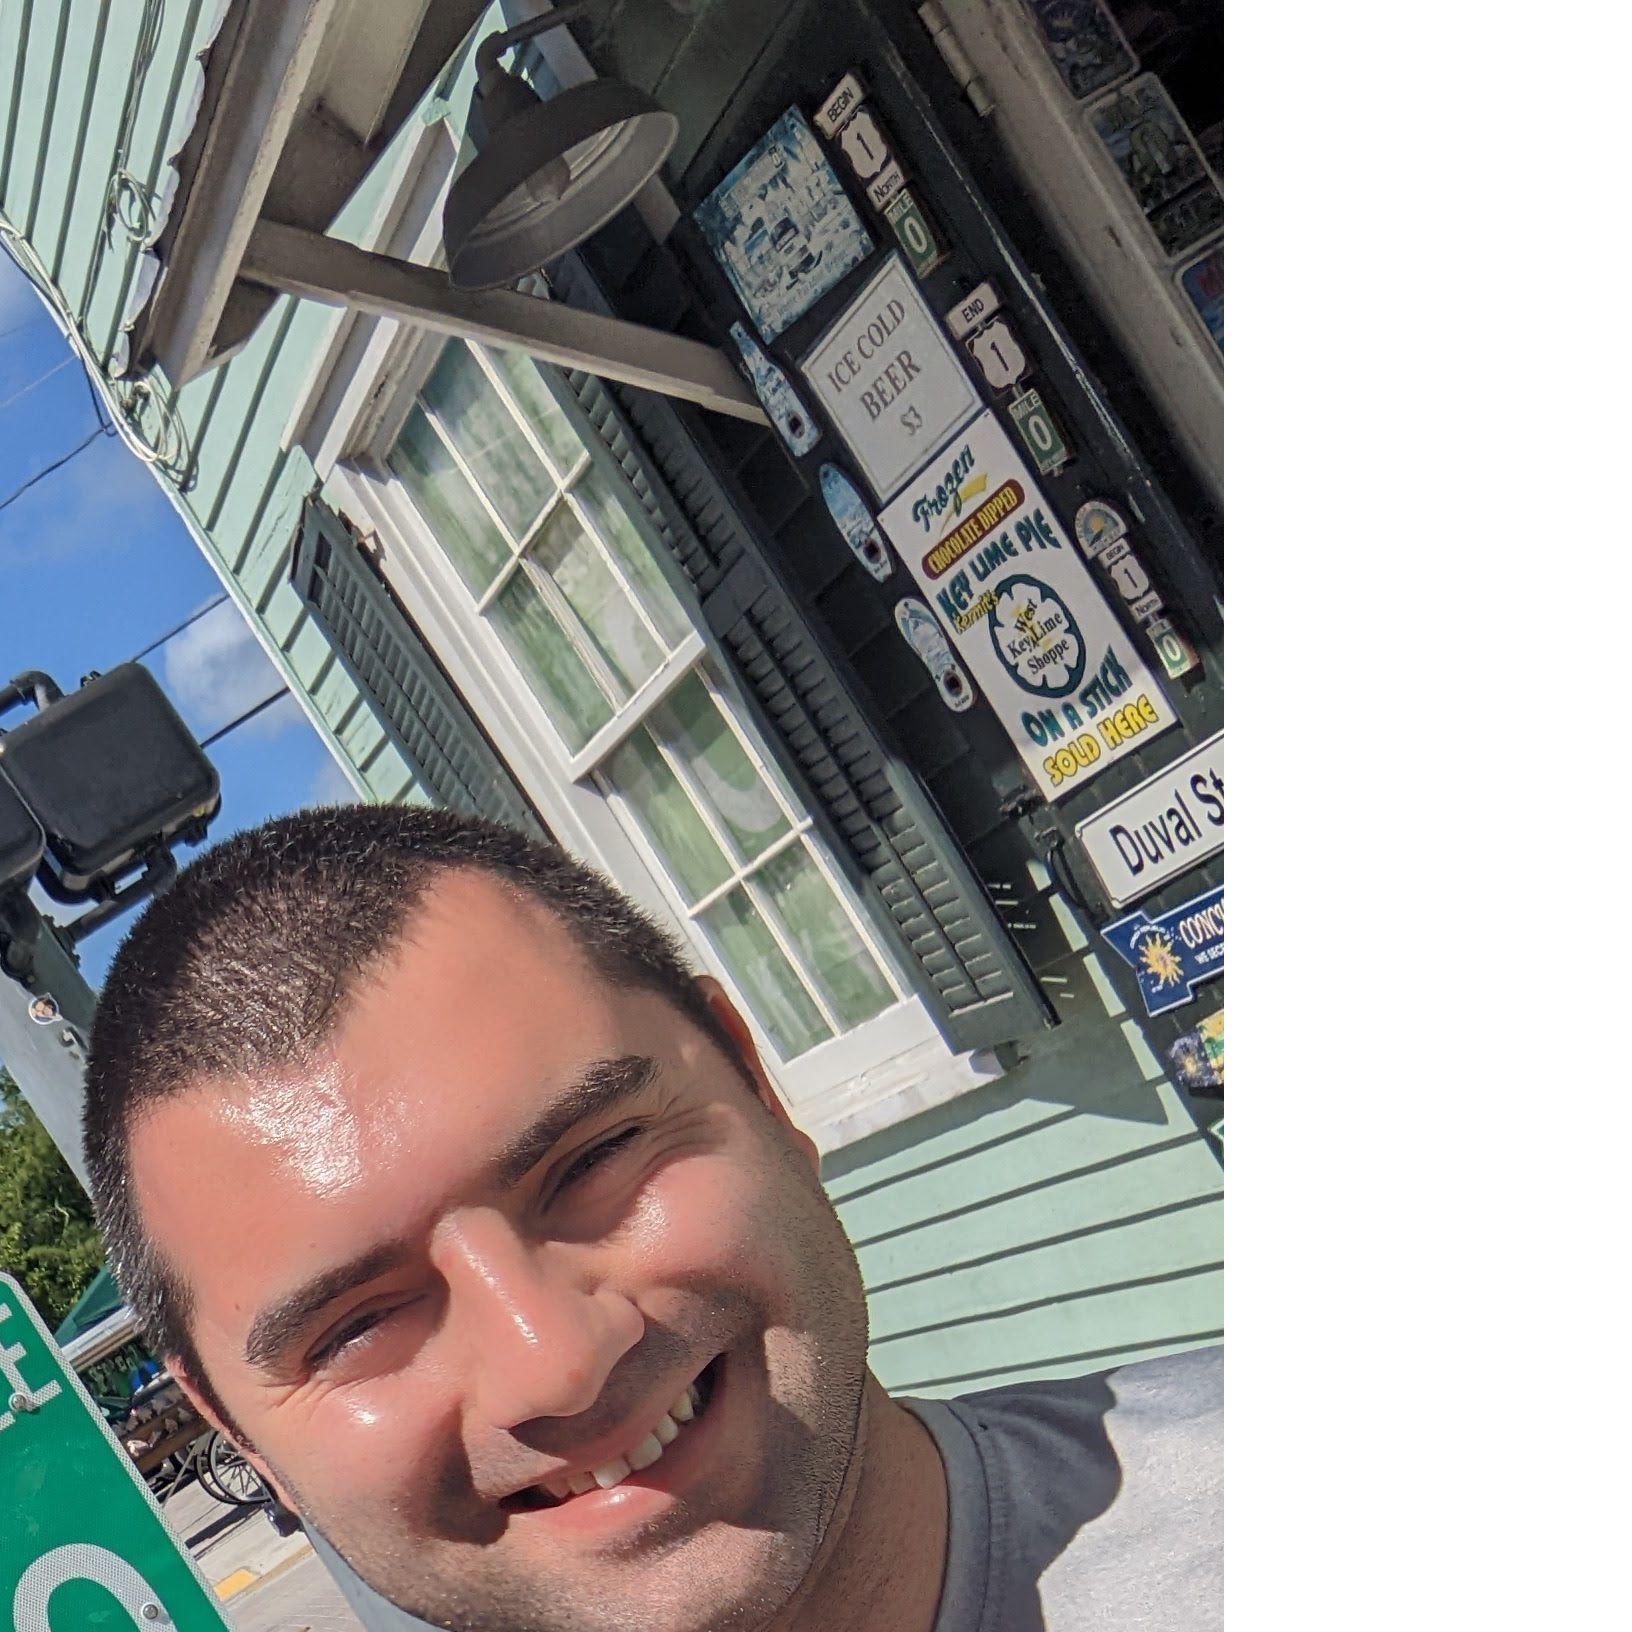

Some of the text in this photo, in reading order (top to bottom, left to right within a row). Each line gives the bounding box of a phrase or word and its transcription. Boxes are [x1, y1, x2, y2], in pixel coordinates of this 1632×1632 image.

[827, 87, 854, 122] BEGIN
[857, 132, 873, 160] 1
[904, 217, 927, 253] 0
[961, 299, 985, 323] END
[827, 300, 905, 392] ICE COLD
[990, 341, 1009, 372] 1
[859, 350, 921, 421] BEER
[1011, 393, 1041, 418] MILE
[1028, 414, 1052, 450] 0
[911, 444, 976, 533] Frozen
[927, 486, 1018, 574] CHOCOLATE DIPPED
[935, 569, 974, 632] KEY
[968, 531, 1019, 583] LIME
[1014, 507, 1063, 553] PIE
[1123, 568, 1138, 589] 1
[1027, 638, 1069, 675] Shoppe
[1162, 635, 1181, 661] 0
[1021, 643, 1133, 747] ON A STICK
[1043, 693, 1159, 788] SOLD HERE
[1109, 788, 1203, 876] Duval
